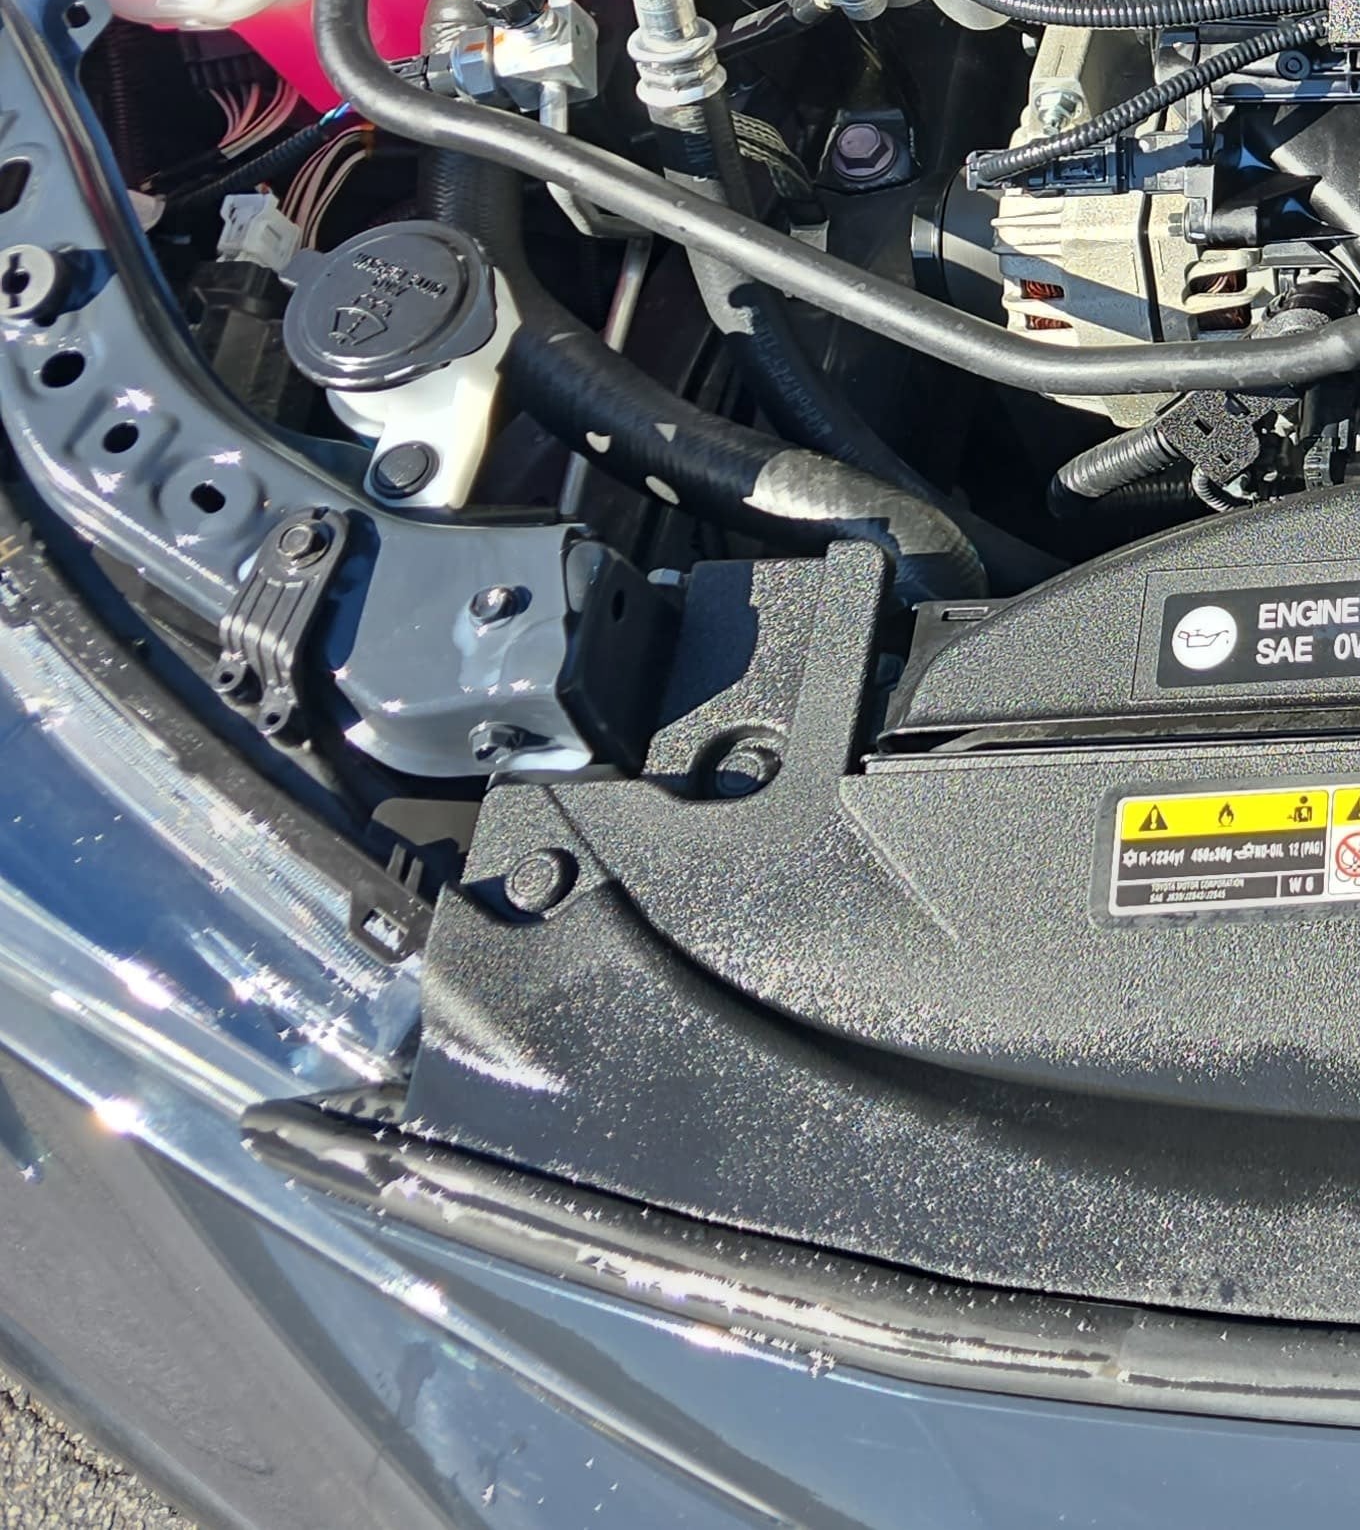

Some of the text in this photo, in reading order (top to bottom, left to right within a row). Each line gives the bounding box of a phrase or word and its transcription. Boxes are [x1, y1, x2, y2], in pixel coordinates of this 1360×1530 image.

[1258, 597, 1360, 630] ENGINE
[1256, 636, 1314, 665] SAE
[1300, 840, 1324, 859] (PAG)
